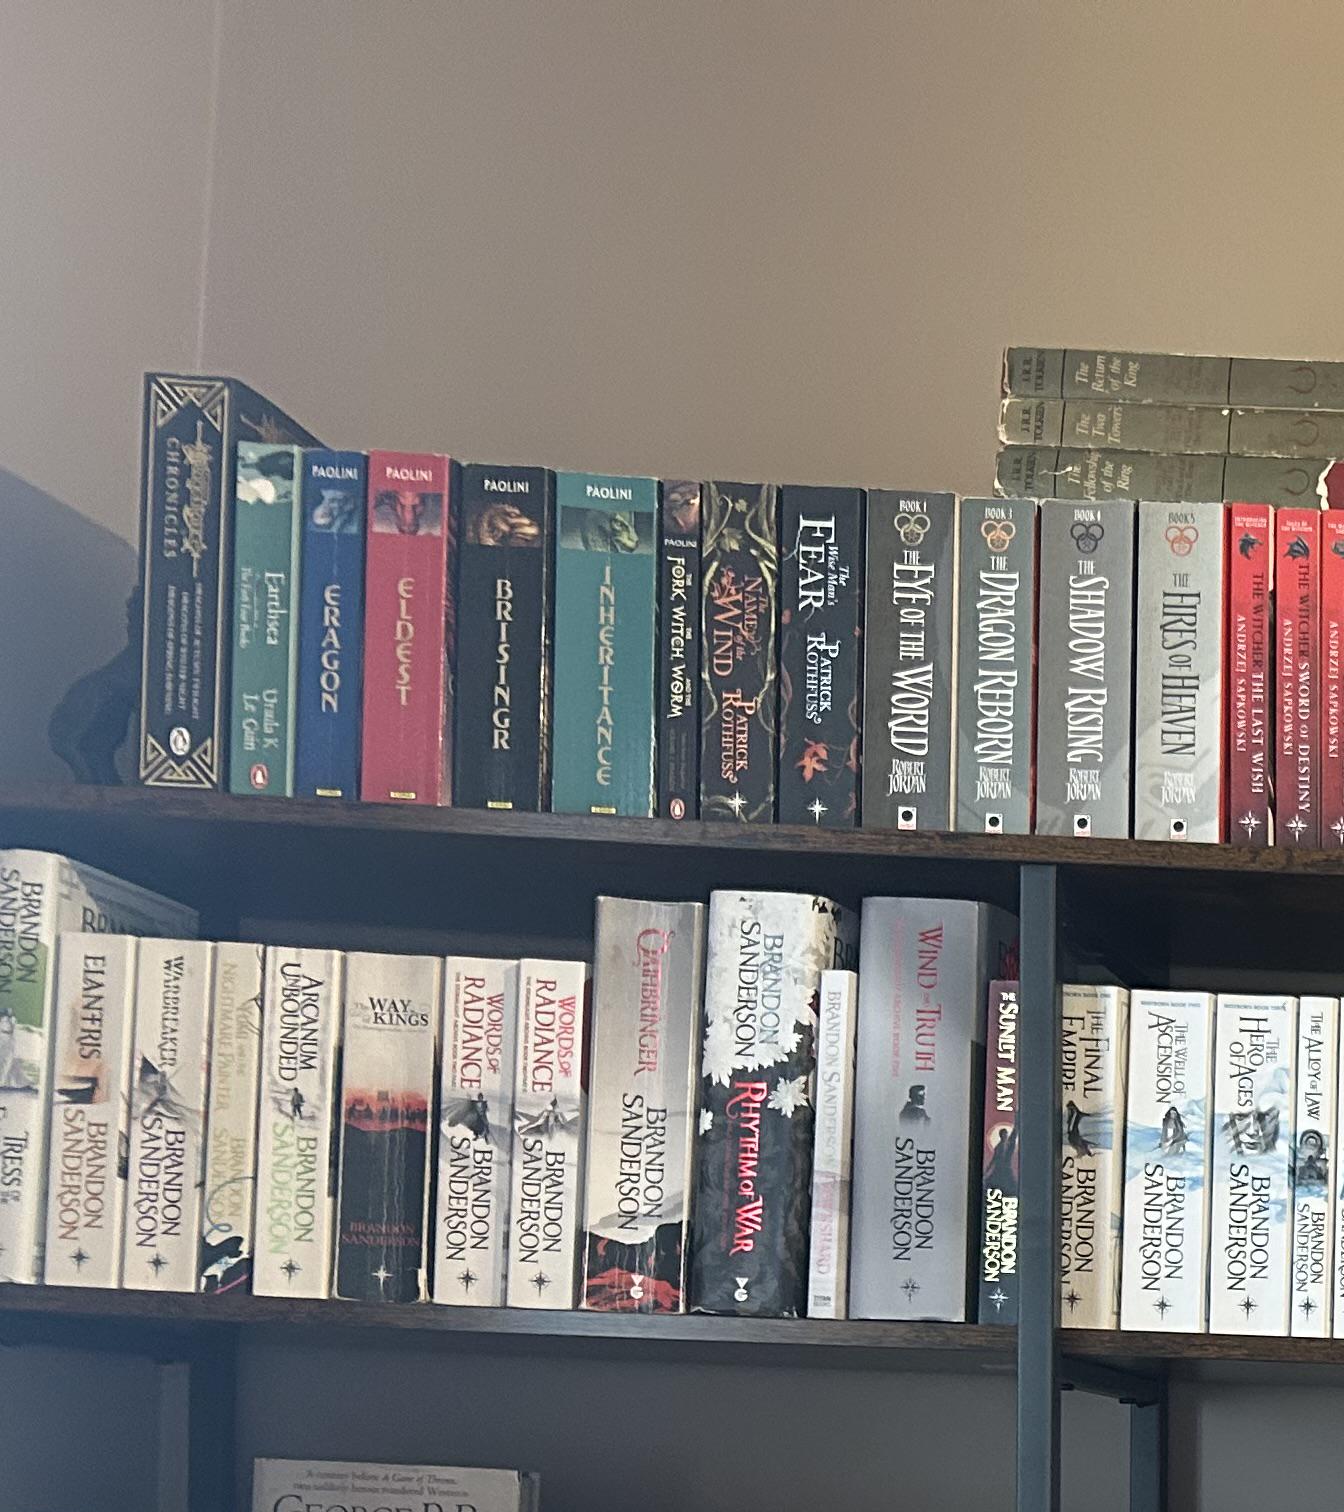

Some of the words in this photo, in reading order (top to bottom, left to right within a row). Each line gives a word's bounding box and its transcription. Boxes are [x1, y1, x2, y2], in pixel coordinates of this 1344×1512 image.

[312, 464, 358, 481] PAOLINI
[797, 515, 835, 623] FEAR
[893, 563, 936, 605] EYE
[899, 607, 924, 627] OF
[322, 585, 340, 713] ERAGON
[394, 578, 412, 707] ELDEST
[492, 578, 514, 751] BRISINGR
[597, 565, 614, 787] INHERITANCE
[899, 630, 925, 660] THE
[888, 663, 933, 756] WORLD
[277, 962, 299, 1083] UNBOUNDED
[302, 976, 323, 1071] ARCANUM
[369, 997, 412, 1012] WAY
[374, 1012, 429, 1026] KINGS
[735, 921, 761, 1058] SANDERSON
[762, 933, 784, 1045] BRANDON
